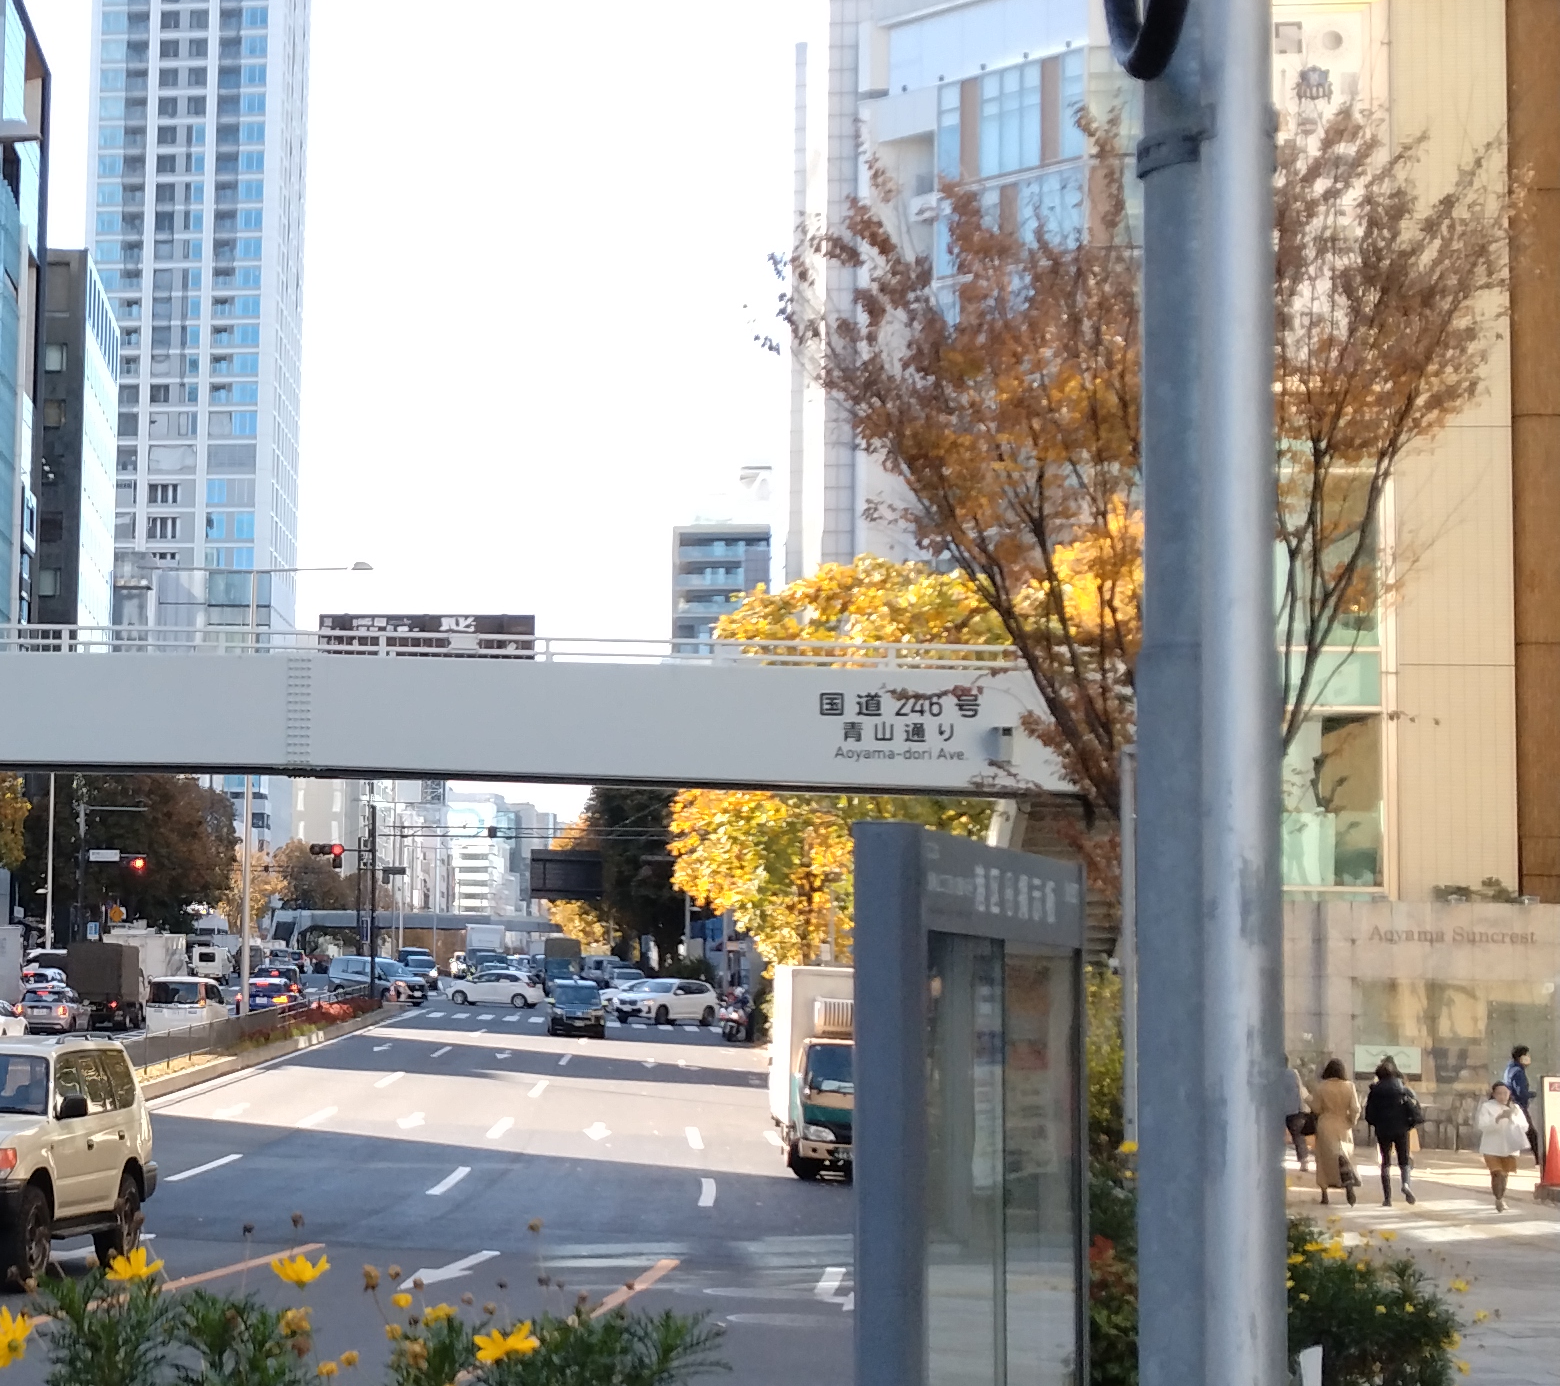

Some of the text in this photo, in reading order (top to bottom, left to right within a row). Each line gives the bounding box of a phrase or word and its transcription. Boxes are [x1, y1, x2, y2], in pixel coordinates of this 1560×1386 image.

[842, 721, 955, 743] 青山通り
[834, 746, 933, 762] Aoyama-dori
[1452, 925, 1538, 945] Suncrest
